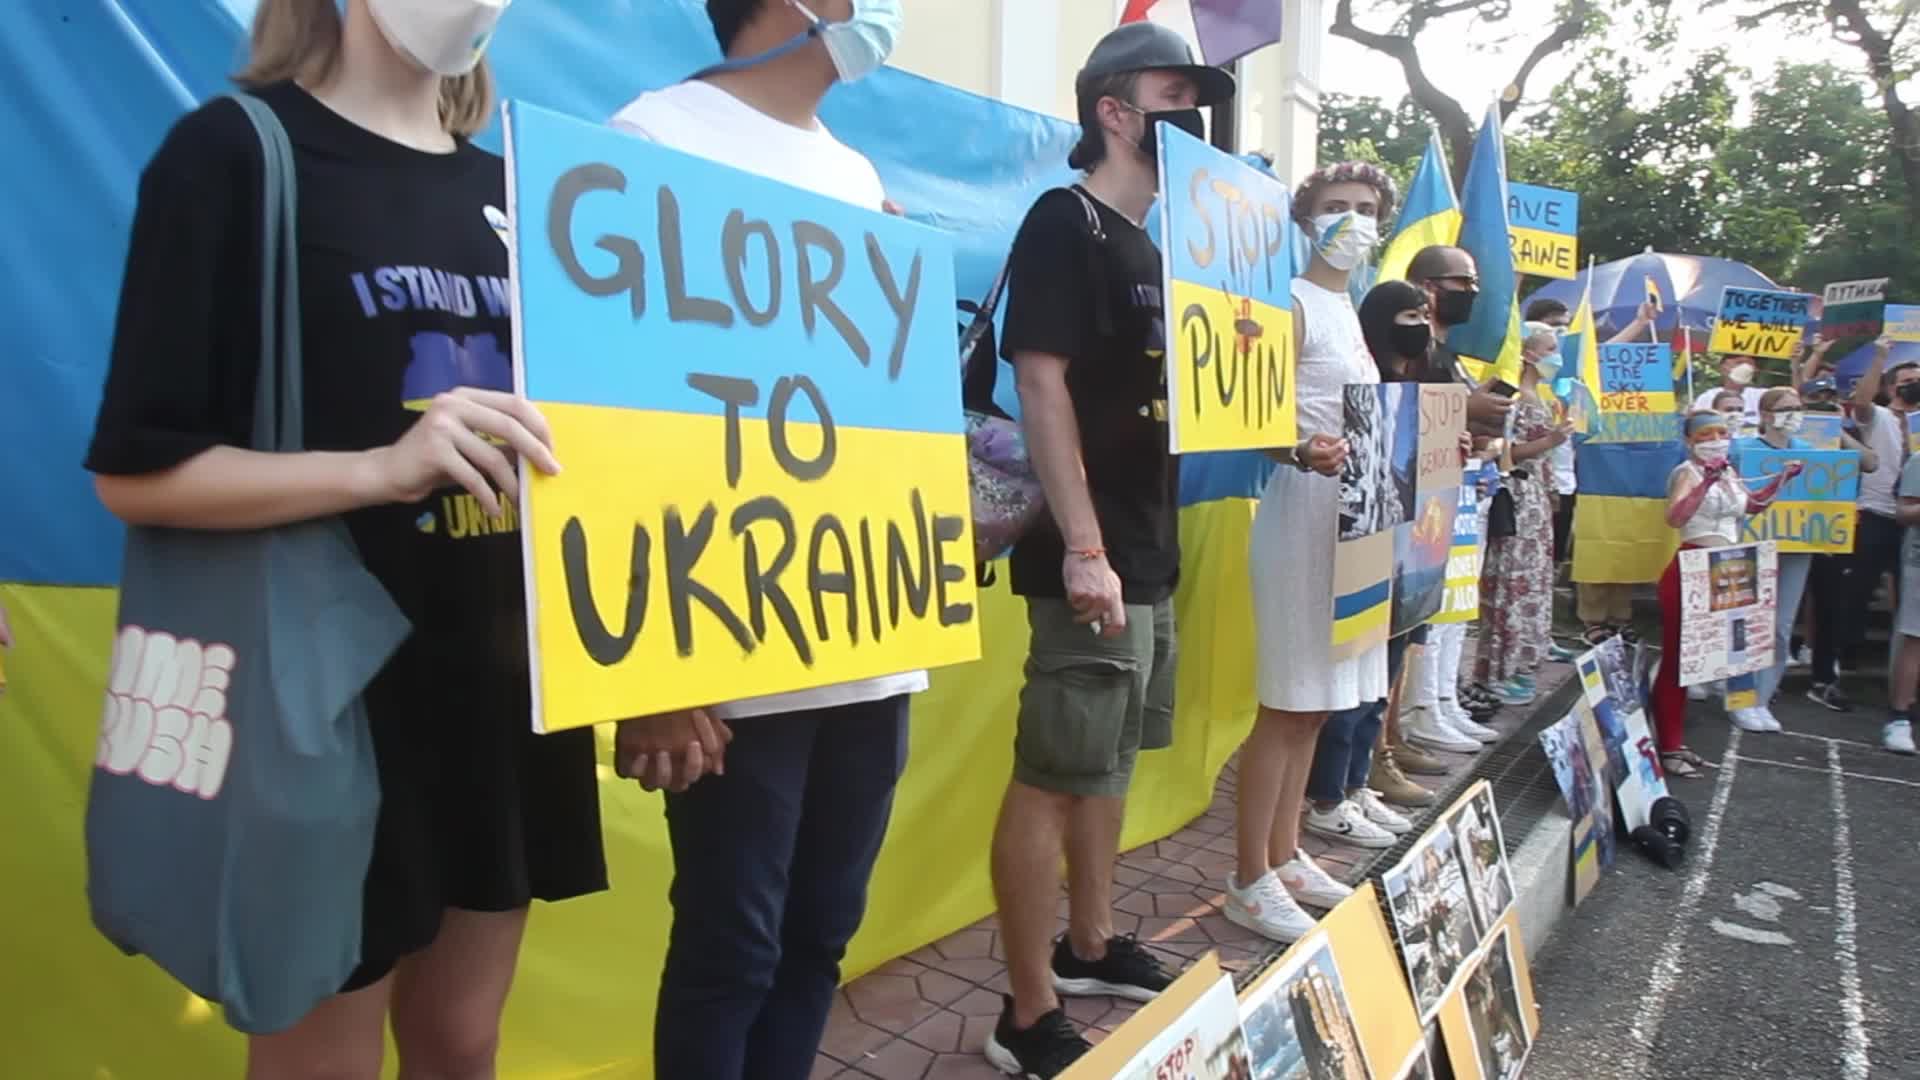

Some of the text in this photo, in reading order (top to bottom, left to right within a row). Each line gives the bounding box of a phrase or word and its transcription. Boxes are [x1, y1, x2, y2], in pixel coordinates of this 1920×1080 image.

[1187, 167, 1283, 294] STOP
[1507, 193, 1562, 227] AVE
[549, 162, 923, 381] GLORY
[1508, 234, 1570, 270] RAINE
[352, 272, 380, 318] I
[373, 265, 477, 318] STAND
[1724, 290, 1808, 315] TOGETHER
[1719, 312, 1798, 334] WE WILL
[1730, 333, 1788, 354] WIN
[1181, 302, 1287, 430] PUTIN
[1600, 345, 1659, 365] LOSE
[1421, 388, 1464, 435] STOP
[1600, 396, 1649, 411] OVER
[685, 374, 839, 489] TO
[1759, 456, 1858, 498] STOP
[561, 488, 973, 668] UKRAINE
